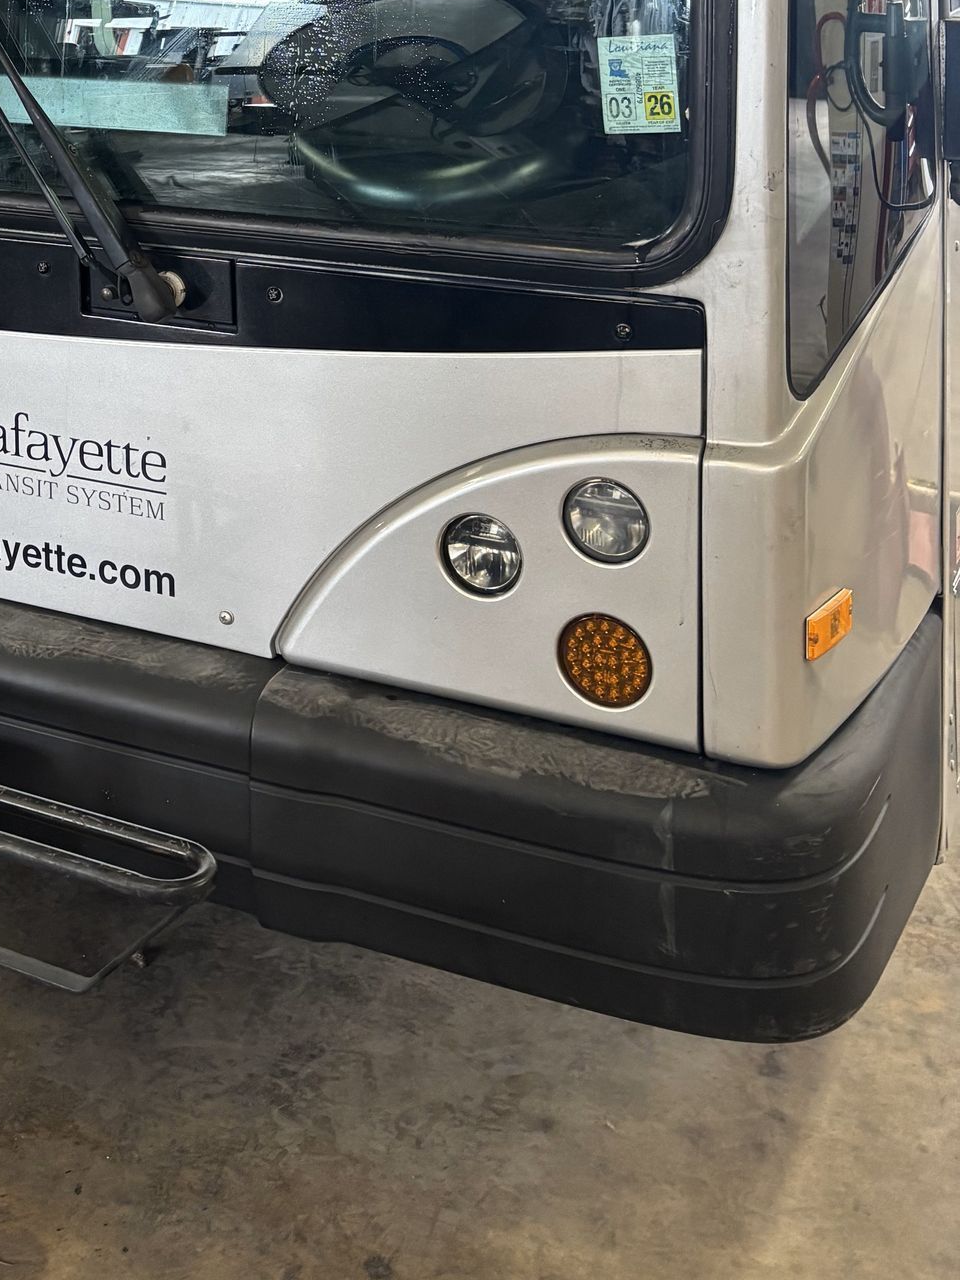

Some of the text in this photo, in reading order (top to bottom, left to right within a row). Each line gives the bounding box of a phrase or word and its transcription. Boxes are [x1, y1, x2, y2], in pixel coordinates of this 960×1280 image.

[608, 96, 632, 119] 03
[647, 93, 673, 116] 26
[65, 484, 167, 522] SYSTEM
